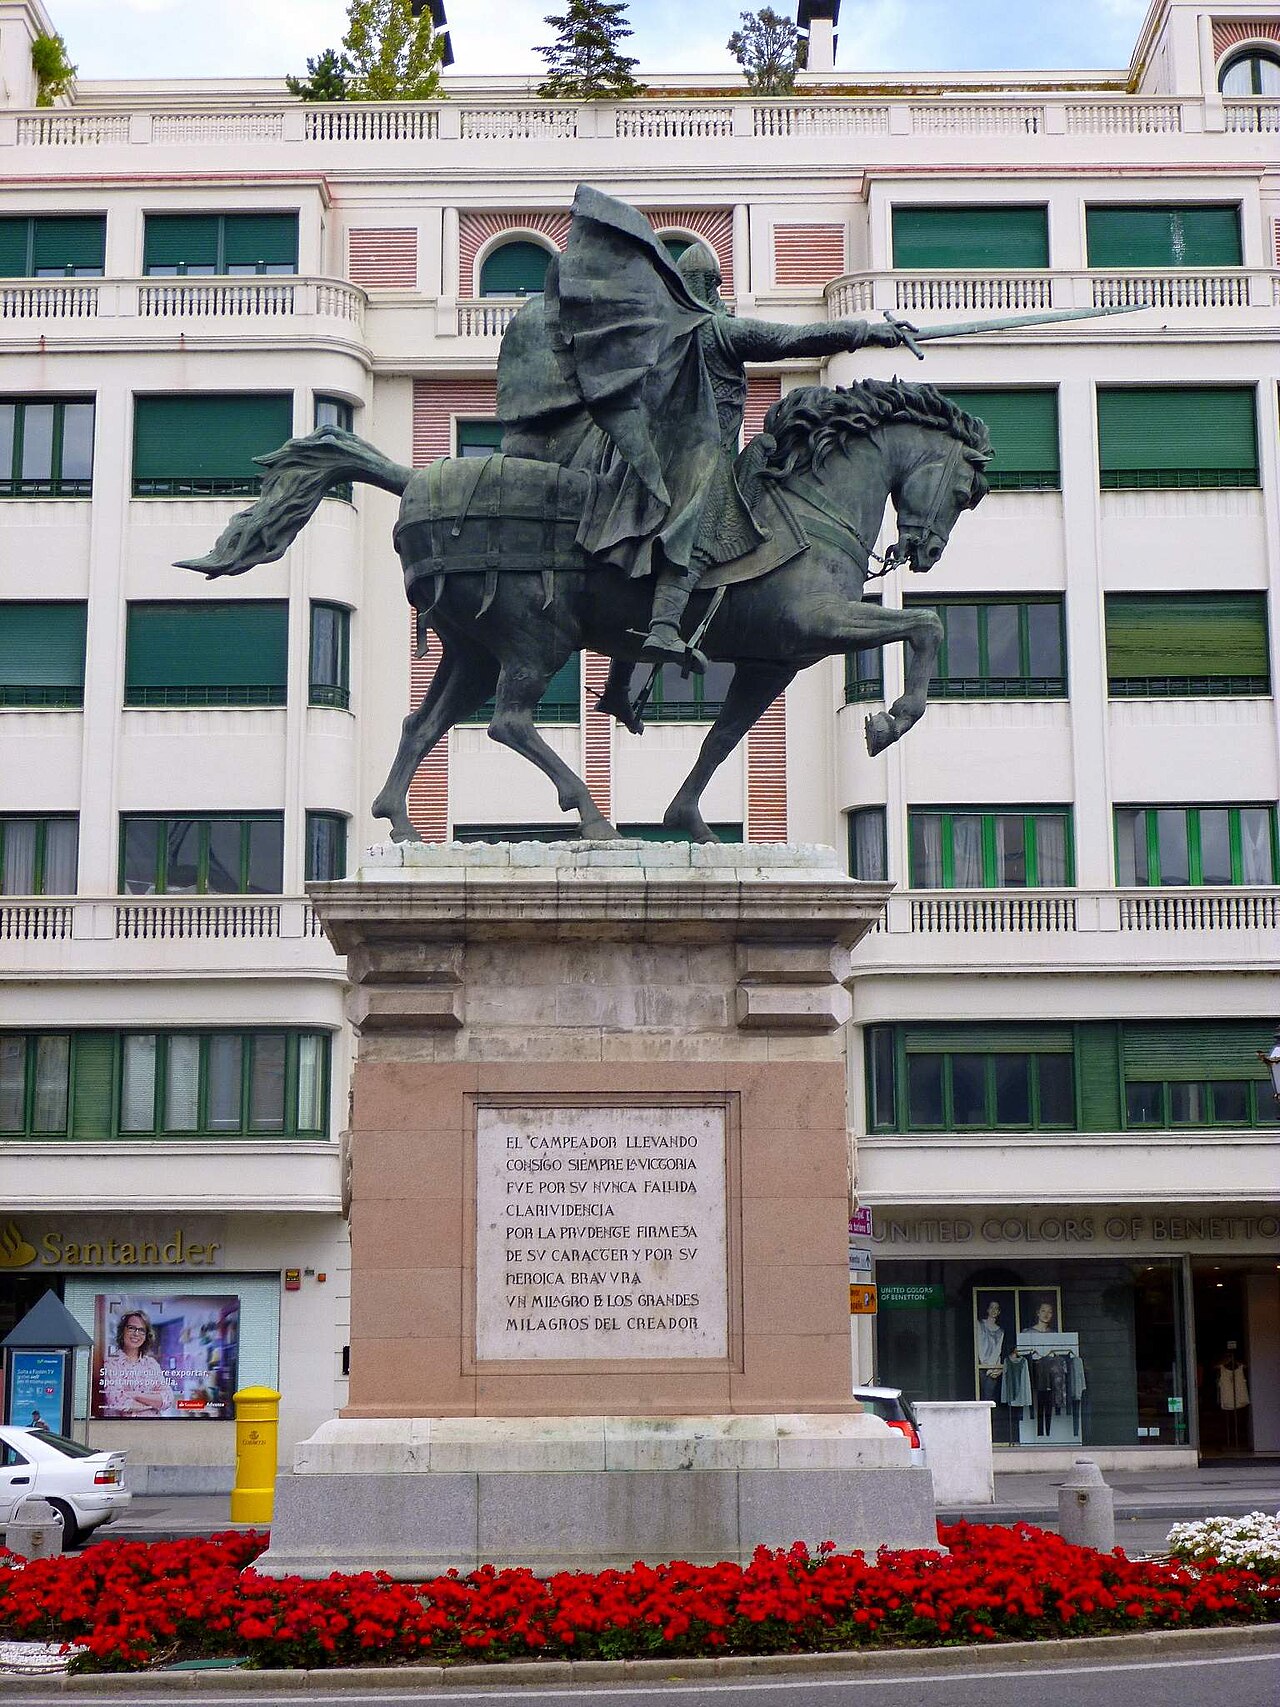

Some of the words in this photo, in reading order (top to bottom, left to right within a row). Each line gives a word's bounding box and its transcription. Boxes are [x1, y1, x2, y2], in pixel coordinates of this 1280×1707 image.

[506, 1136, 523, 1149] EL
[530, 1135, 617, 1149] CAMPEADOR
[626, 1135, 698, 1149] LLEVANDO
[506, 1158, 562, 1172] CONSIGO
[568, 1158, 624, 1172] SIEMPRE
[626, 1158, 638, 1171] LA
[539, 1181, 566, 1194] POR
[644, 1180, 698, 1194] FALLIDA
[506, 1203, 615, 1217] CLARIVIDENCIA
[505, 1226, 534, 1240] POR
[538, 1226, 557, 1240] LA
[872, 1219, 974, 1243] UNITED
[982, 1218, 1094, 1242] COLORS
[1105, 1218, 1143, 1241] OF
[41, 1228, 220, 1265] Santander
[631, 1248, 641, 1262] Y
[645, 1248, 673, 1261] POR
[531, 1294, 590, 1308] MILAGRO
[607, 1294, 633, 1308] LOS
[637, 1293, 700, 1307] GRANDES
[505, 1318, 589, 1331] MILAGROS
[594, 1318, 621, 1331] DEL
[626, 1316, 699, 1332] CREADOR
